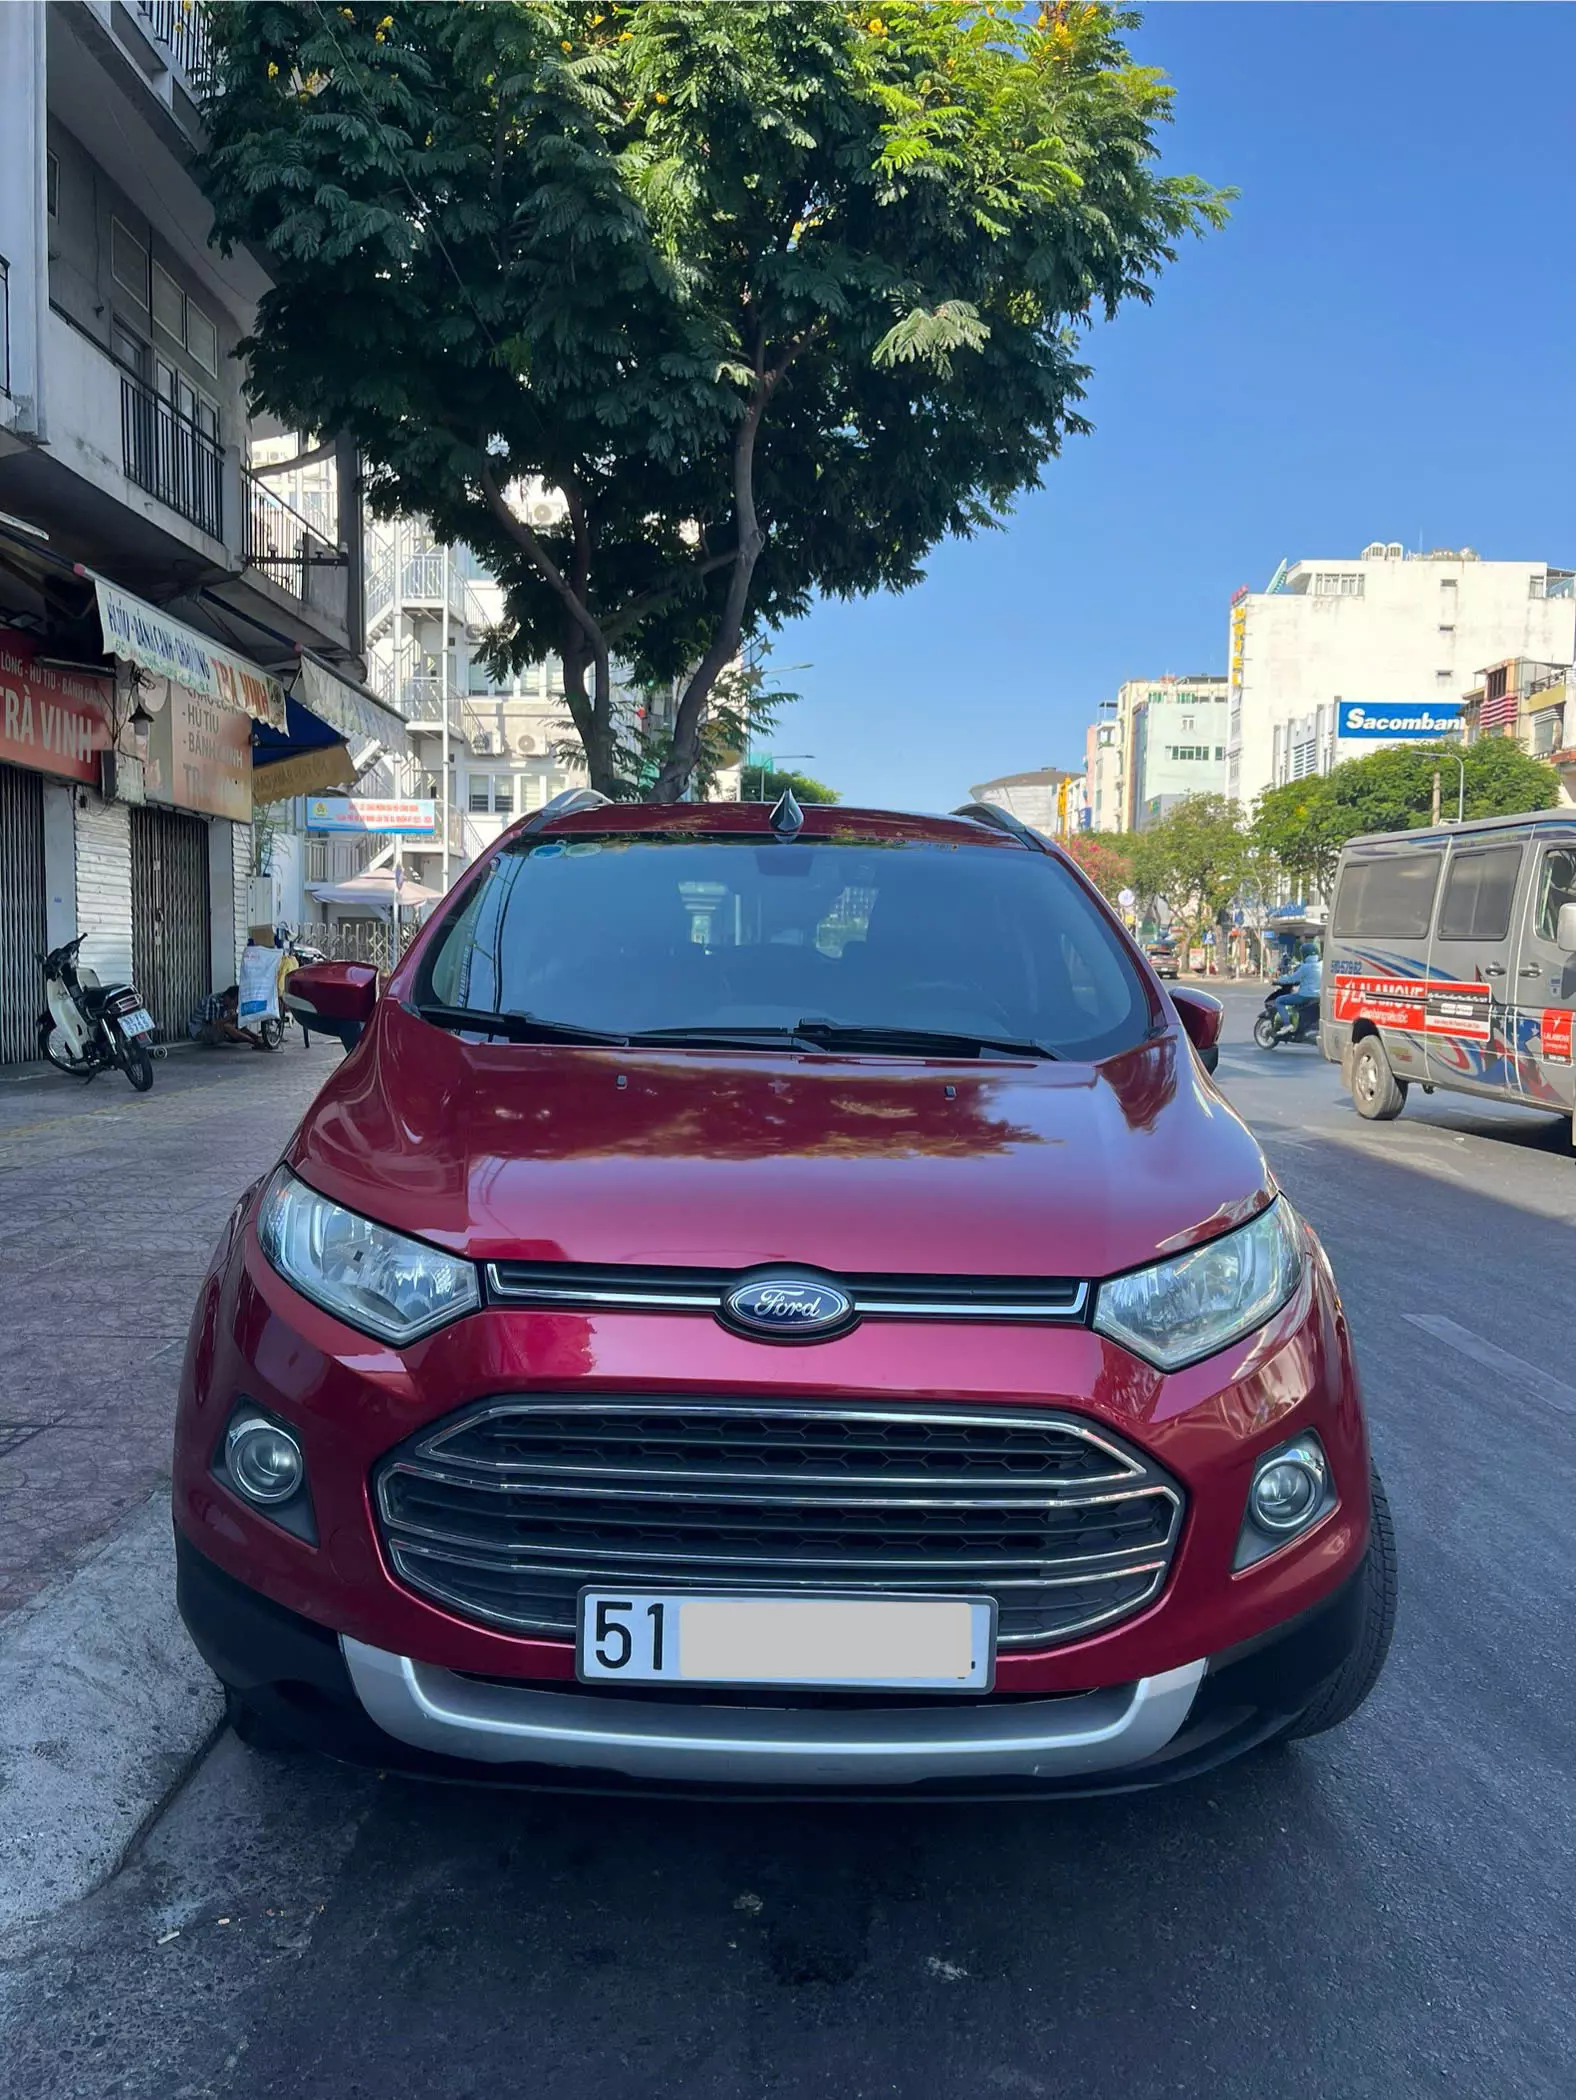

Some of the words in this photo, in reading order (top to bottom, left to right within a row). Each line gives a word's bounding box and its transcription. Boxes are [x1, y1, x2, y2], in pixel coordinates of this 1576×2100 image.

[1, 650, 23, 678] LÒNG
[40, 700, 92, 764] VINH
[754, 1289, 821, 1317] Ford
